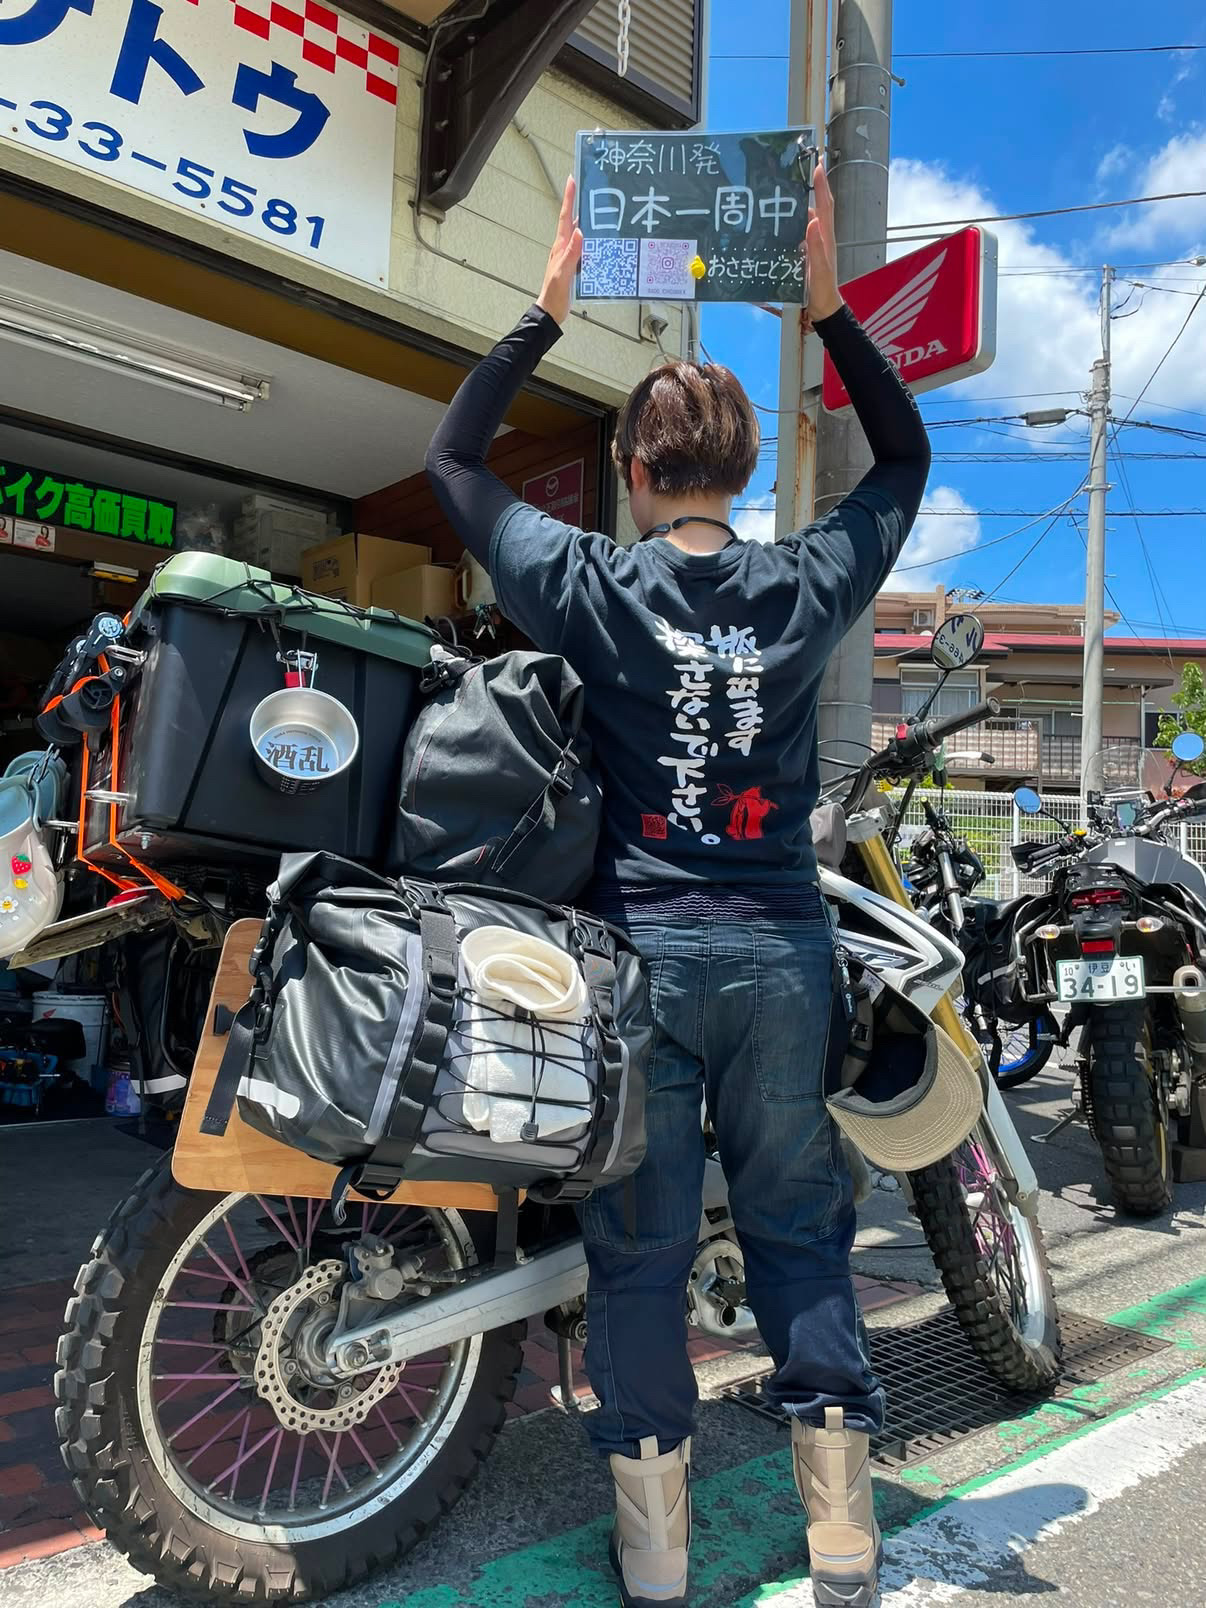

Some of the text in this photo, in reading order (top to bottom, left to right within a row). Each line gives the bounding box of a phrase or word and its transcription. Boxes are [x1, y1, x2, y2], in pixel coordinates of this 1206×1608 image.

[594, 139, 722, 175] 神奈川発
[588, 185, 798, 237] 日本一周中
[707, 254, 807, 281] おさきにどうぞ
[886, 339, 948, 371] NDA
[705, 624, 764, 757] 旅に出ます
[654, 616, 721, 845] 探さないで下さい。
[265, 741, 330, 772] 酒乱
[1088, 962, 1110, 974] 伊豆
[1063, 974, 1139, 998] 34-19
